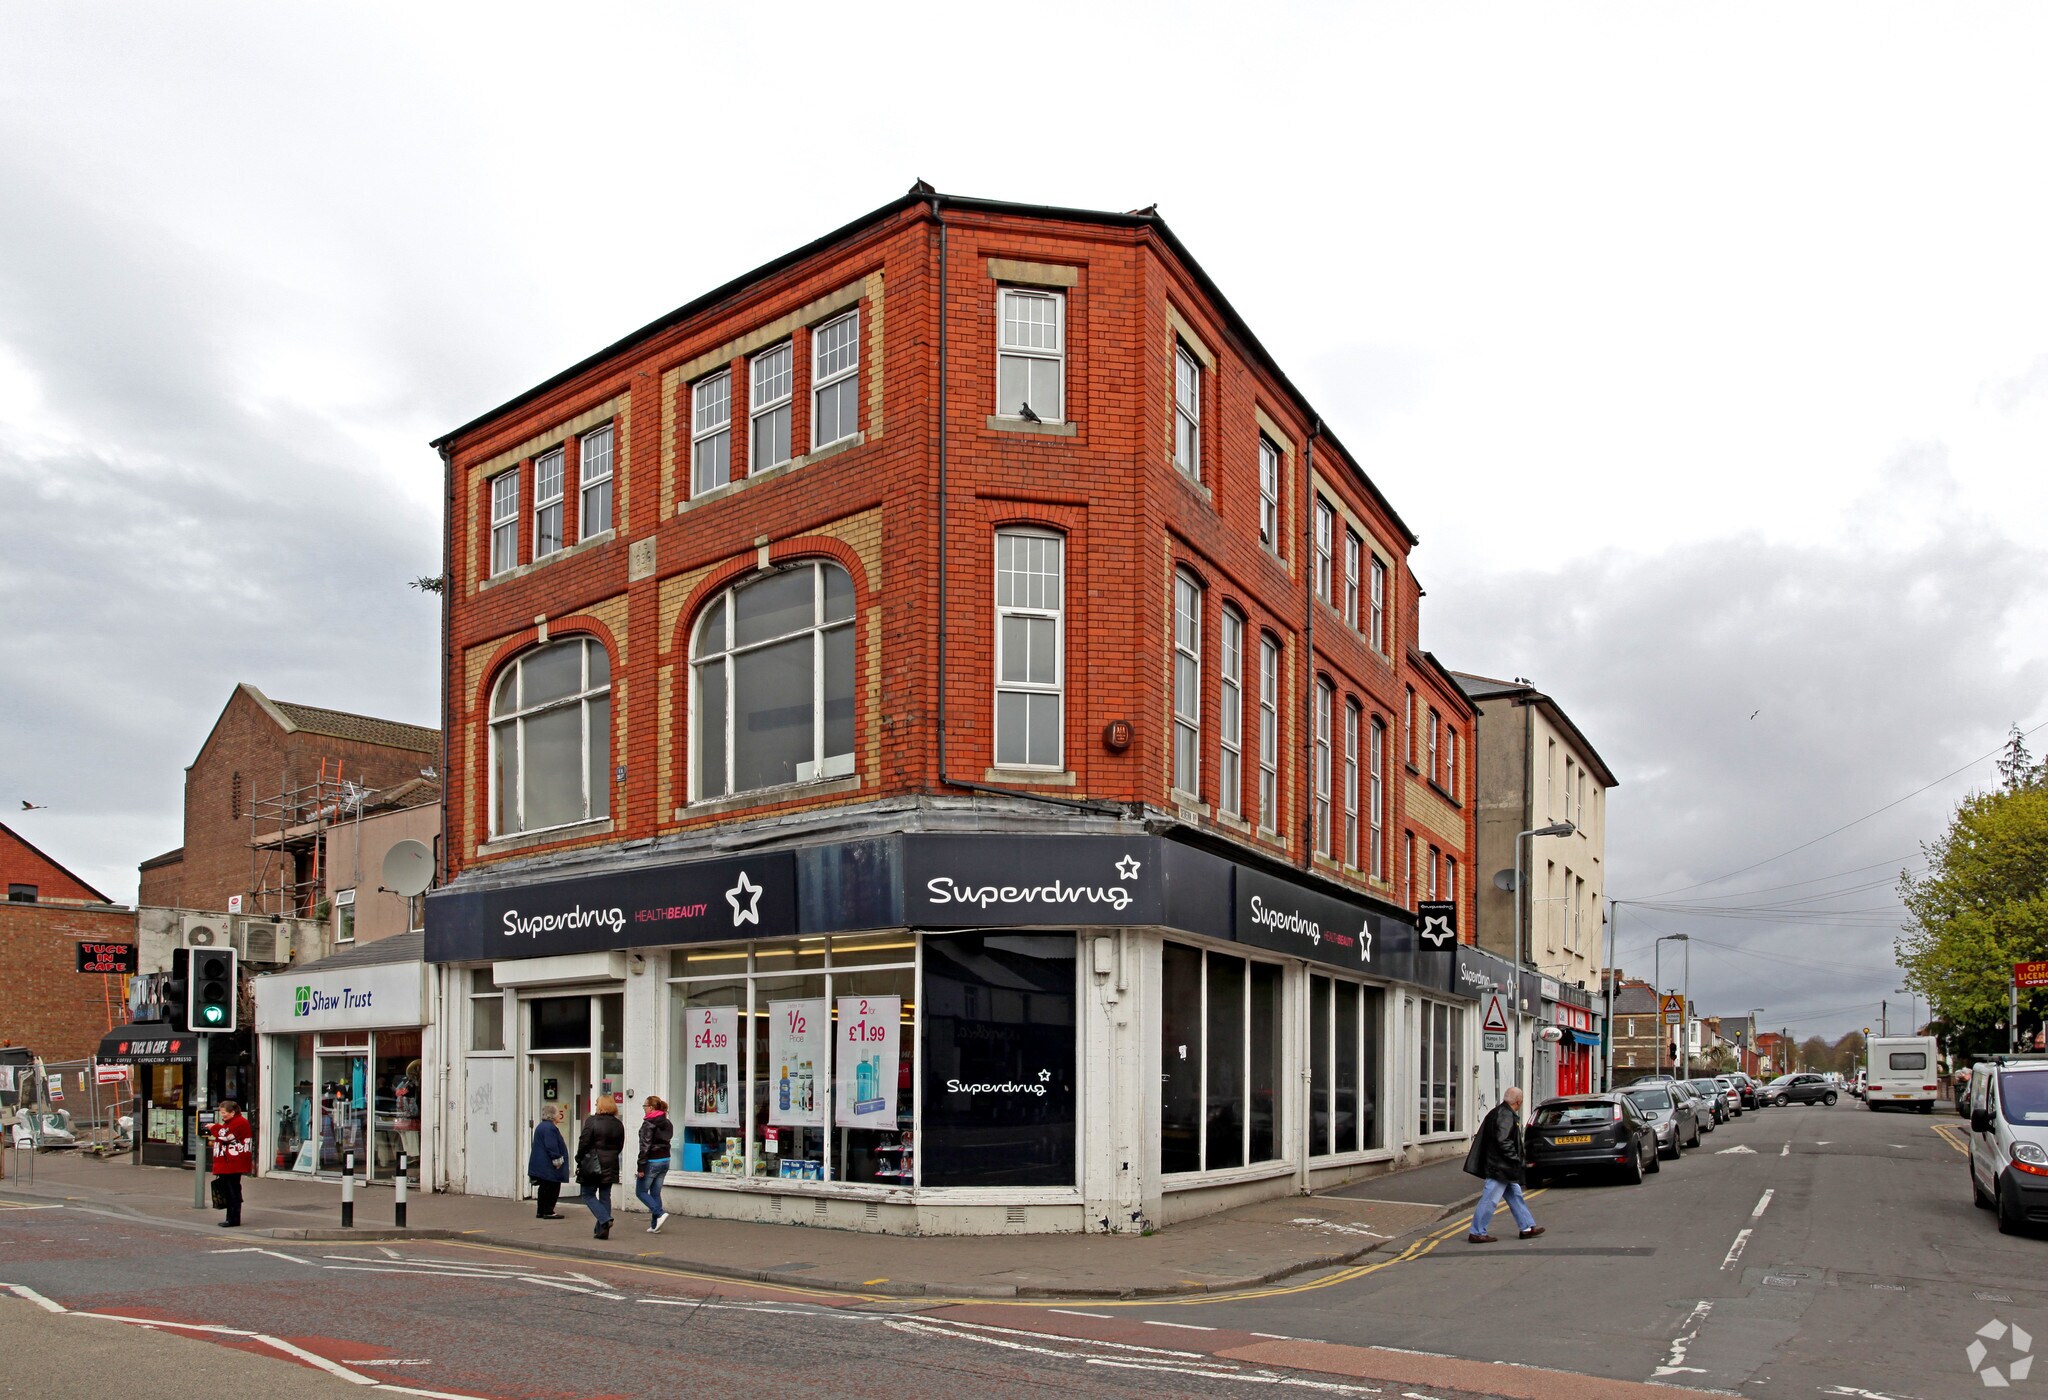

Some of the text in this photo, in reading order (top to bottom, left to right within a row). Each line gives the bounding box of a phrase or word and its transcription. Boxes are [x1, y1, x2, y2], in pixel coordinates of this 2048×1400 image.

[927, 877, 1133, 911] Superdrug
[503, 904, 626, 938] Superdrug
[1250, 895, 1321, 946] Superdrug
[82, 944, 127, 954] TUCK
[97, 953, 113, 962] IN
[84, 962, 126, 971] CAFE
[2027, 964, 2046, 972] OFF
[311, 988, 372, 1010] Shaw Trust
[860, 999, 868, 1015] 2
[704, 1010, 711, 1024] 2
[694, 1028, 728, 1049] £4.99
[849, 1019, 886, 1042] £1.99
[789, 1035, 804, 1043] Price
[130, 1040, 169, 1055] TUCK IN CAFE
[946, 1079, 1047, 1097] Superdrug
